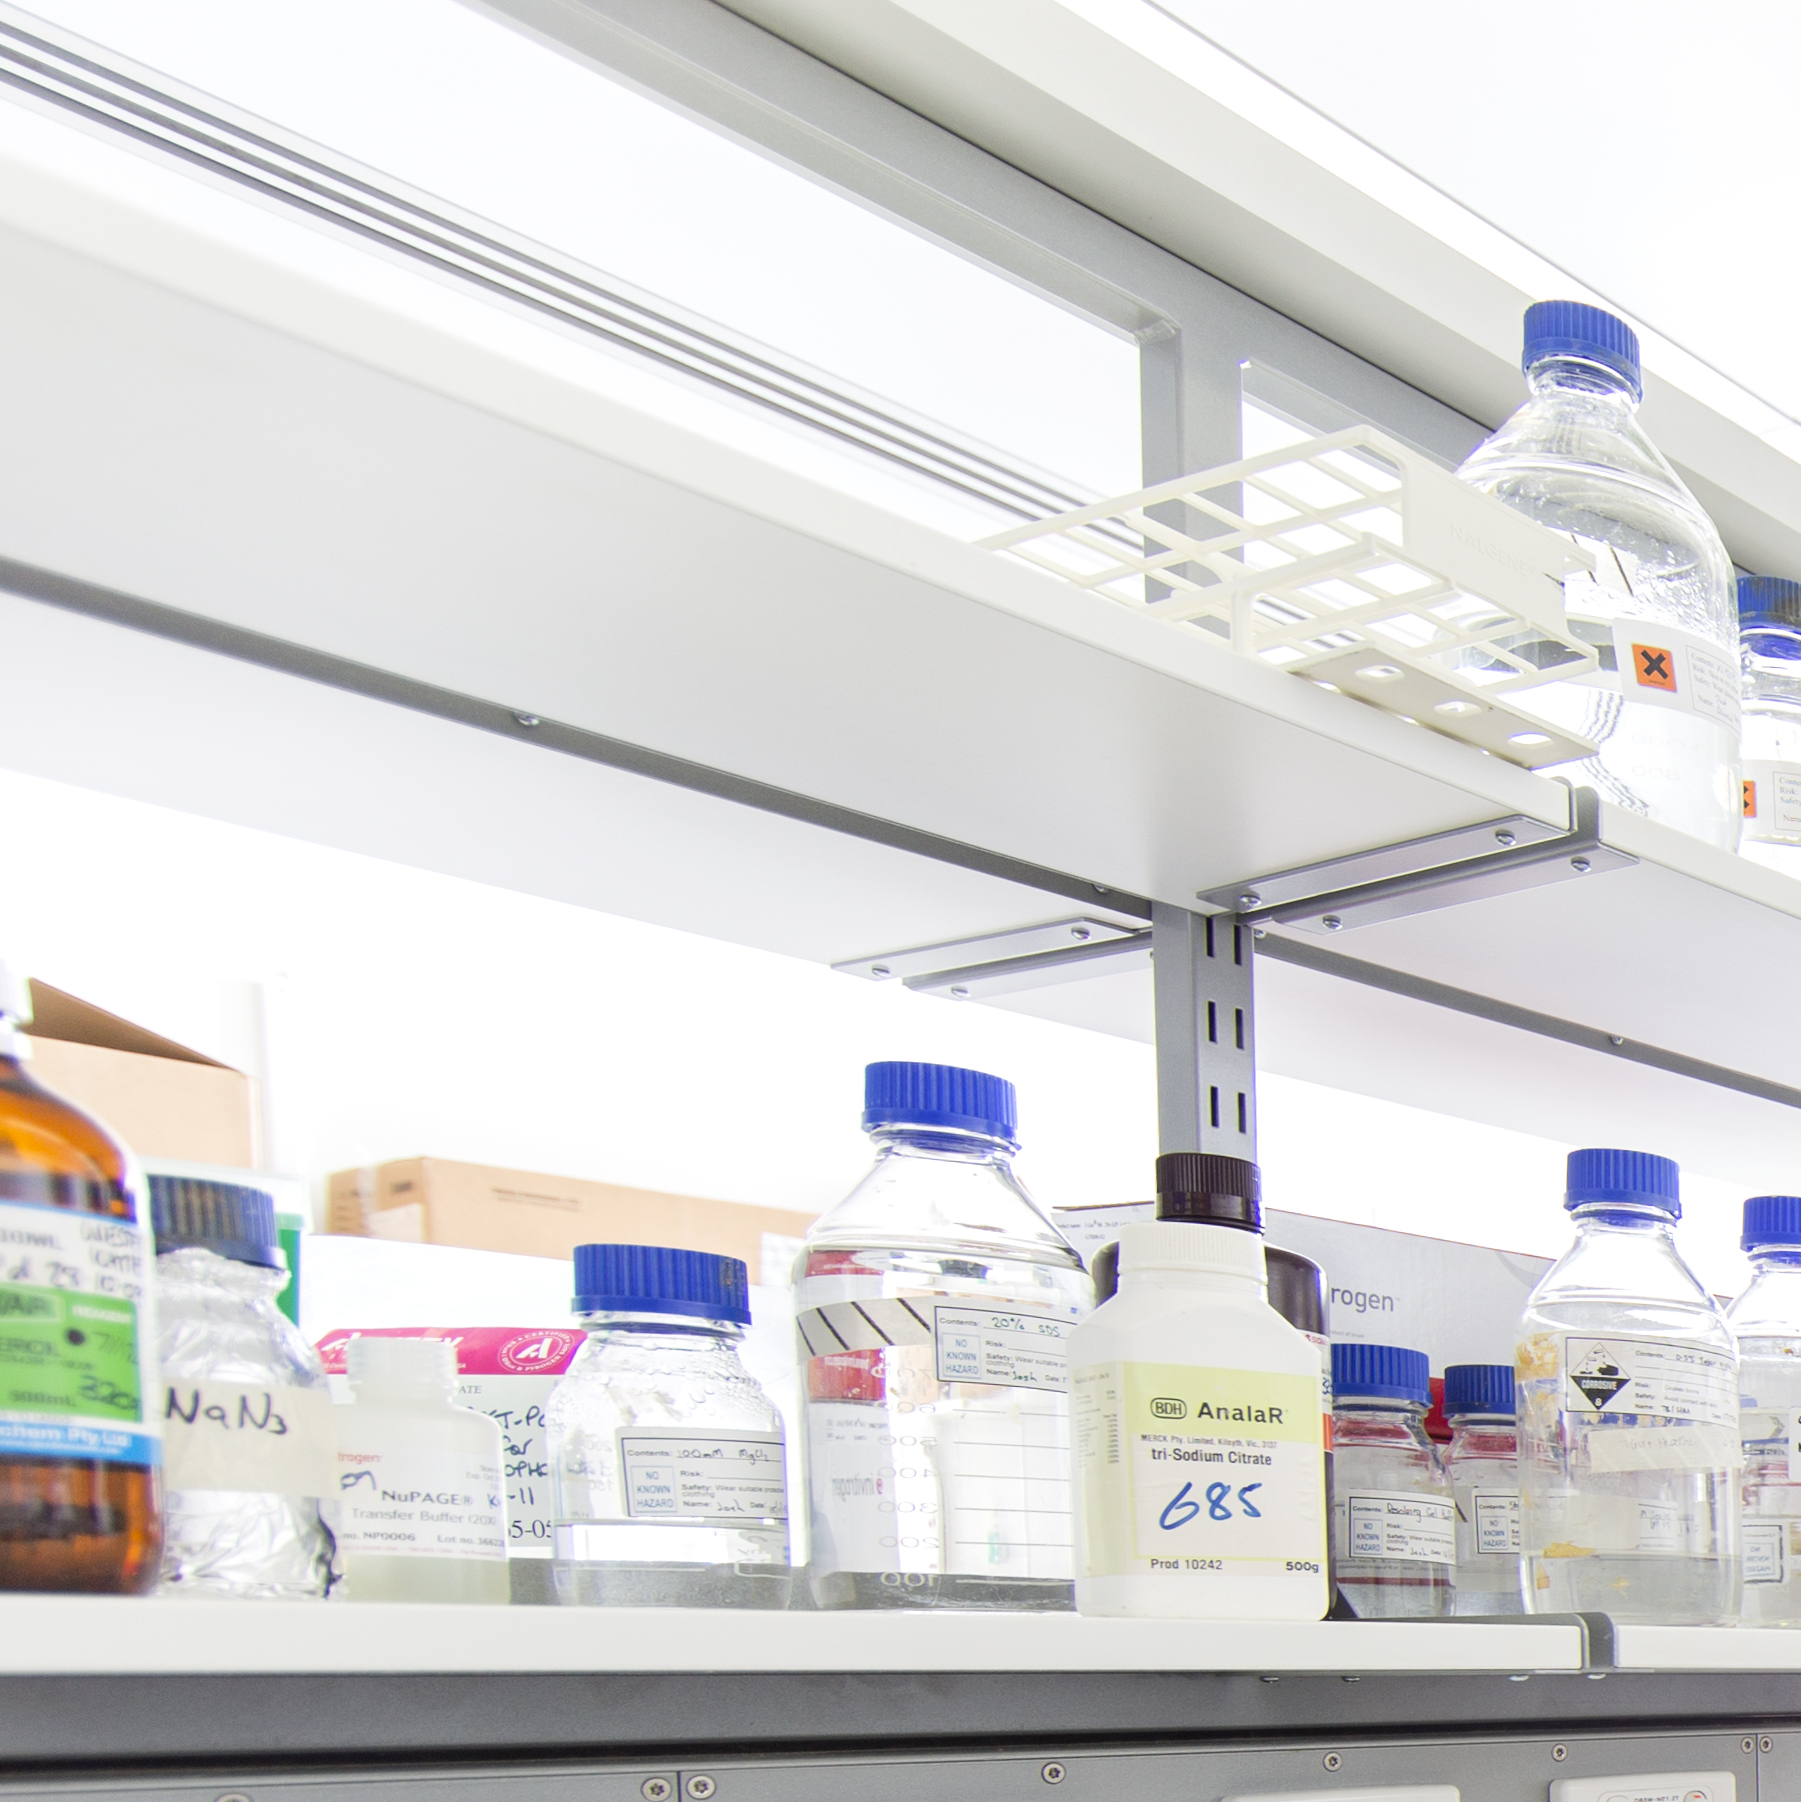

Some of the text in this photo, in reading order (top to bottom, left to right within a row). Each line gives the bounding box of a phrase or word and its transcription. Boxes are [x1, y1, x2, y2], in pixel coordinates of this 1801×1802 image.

[1330, 1287, 1394, 1313] rogen
[955, 1339, 967, 1348] NO
[946, 1352, 976, 1361] KNOWN
[946, 1364, 979, 1374] HAZARD
[459, 1385, 482, 1394] ATE
[1581, 1379, 1618, 1391] CORROSIVE
[1155, 1401, 1284, 1425] BDH AnalaR
[1141, 1434, 1169, 1443] MERCK
[1151, 1448, 1272, 1466] tri-Sodium Citrate
[646, 1471, 660, 1480] NO
[637, 1485, 671, 1494] KNOWN
[637, 1499, 674, 1508] HAZARD
[1159, 1481, 1262, 1530] 685
[1150, 1558, 1223, 1570] Prod 10242
[1285, 1561, 1319, 1573] 500g
